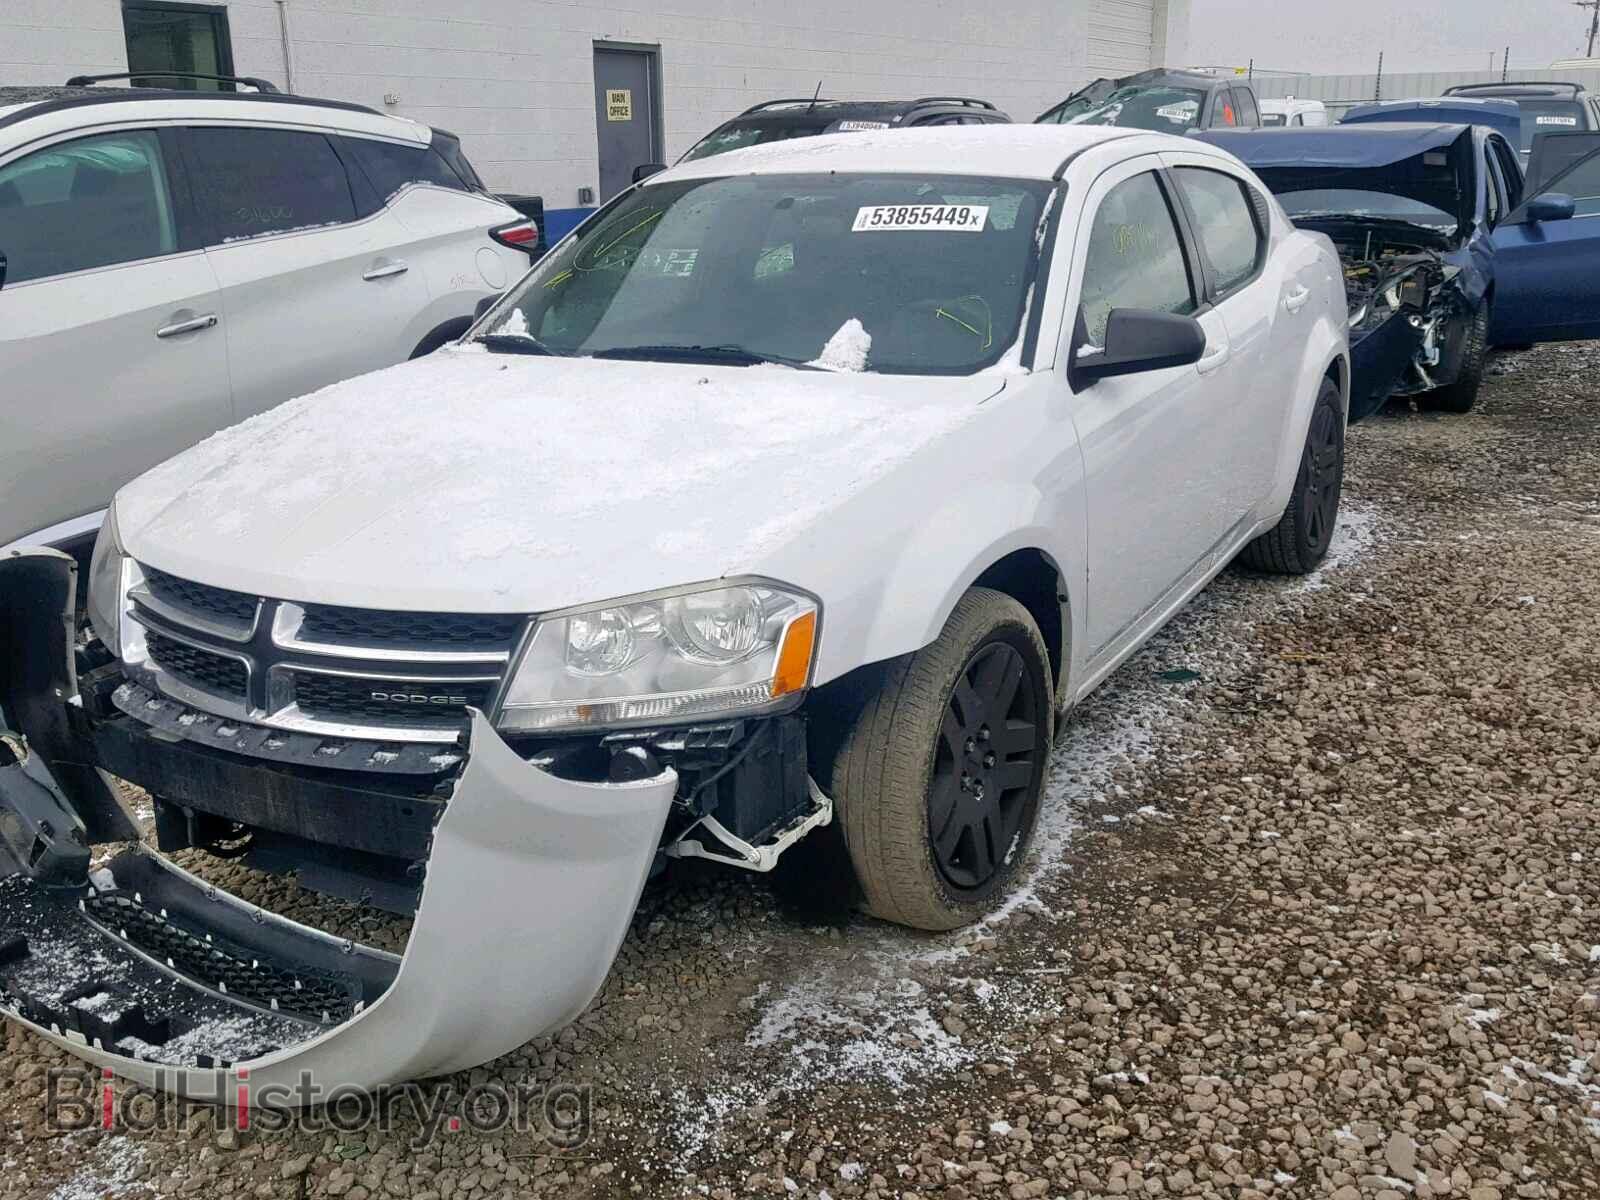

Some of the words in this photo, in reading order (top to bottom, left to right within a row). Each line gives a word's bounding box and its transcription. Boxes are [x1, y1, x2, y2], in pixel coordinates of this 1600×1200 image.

[611, 93, 626, 103] MAIN
[610, 106, 629, 117] OFFICE
[371, 692, 467, 705] DODGE
